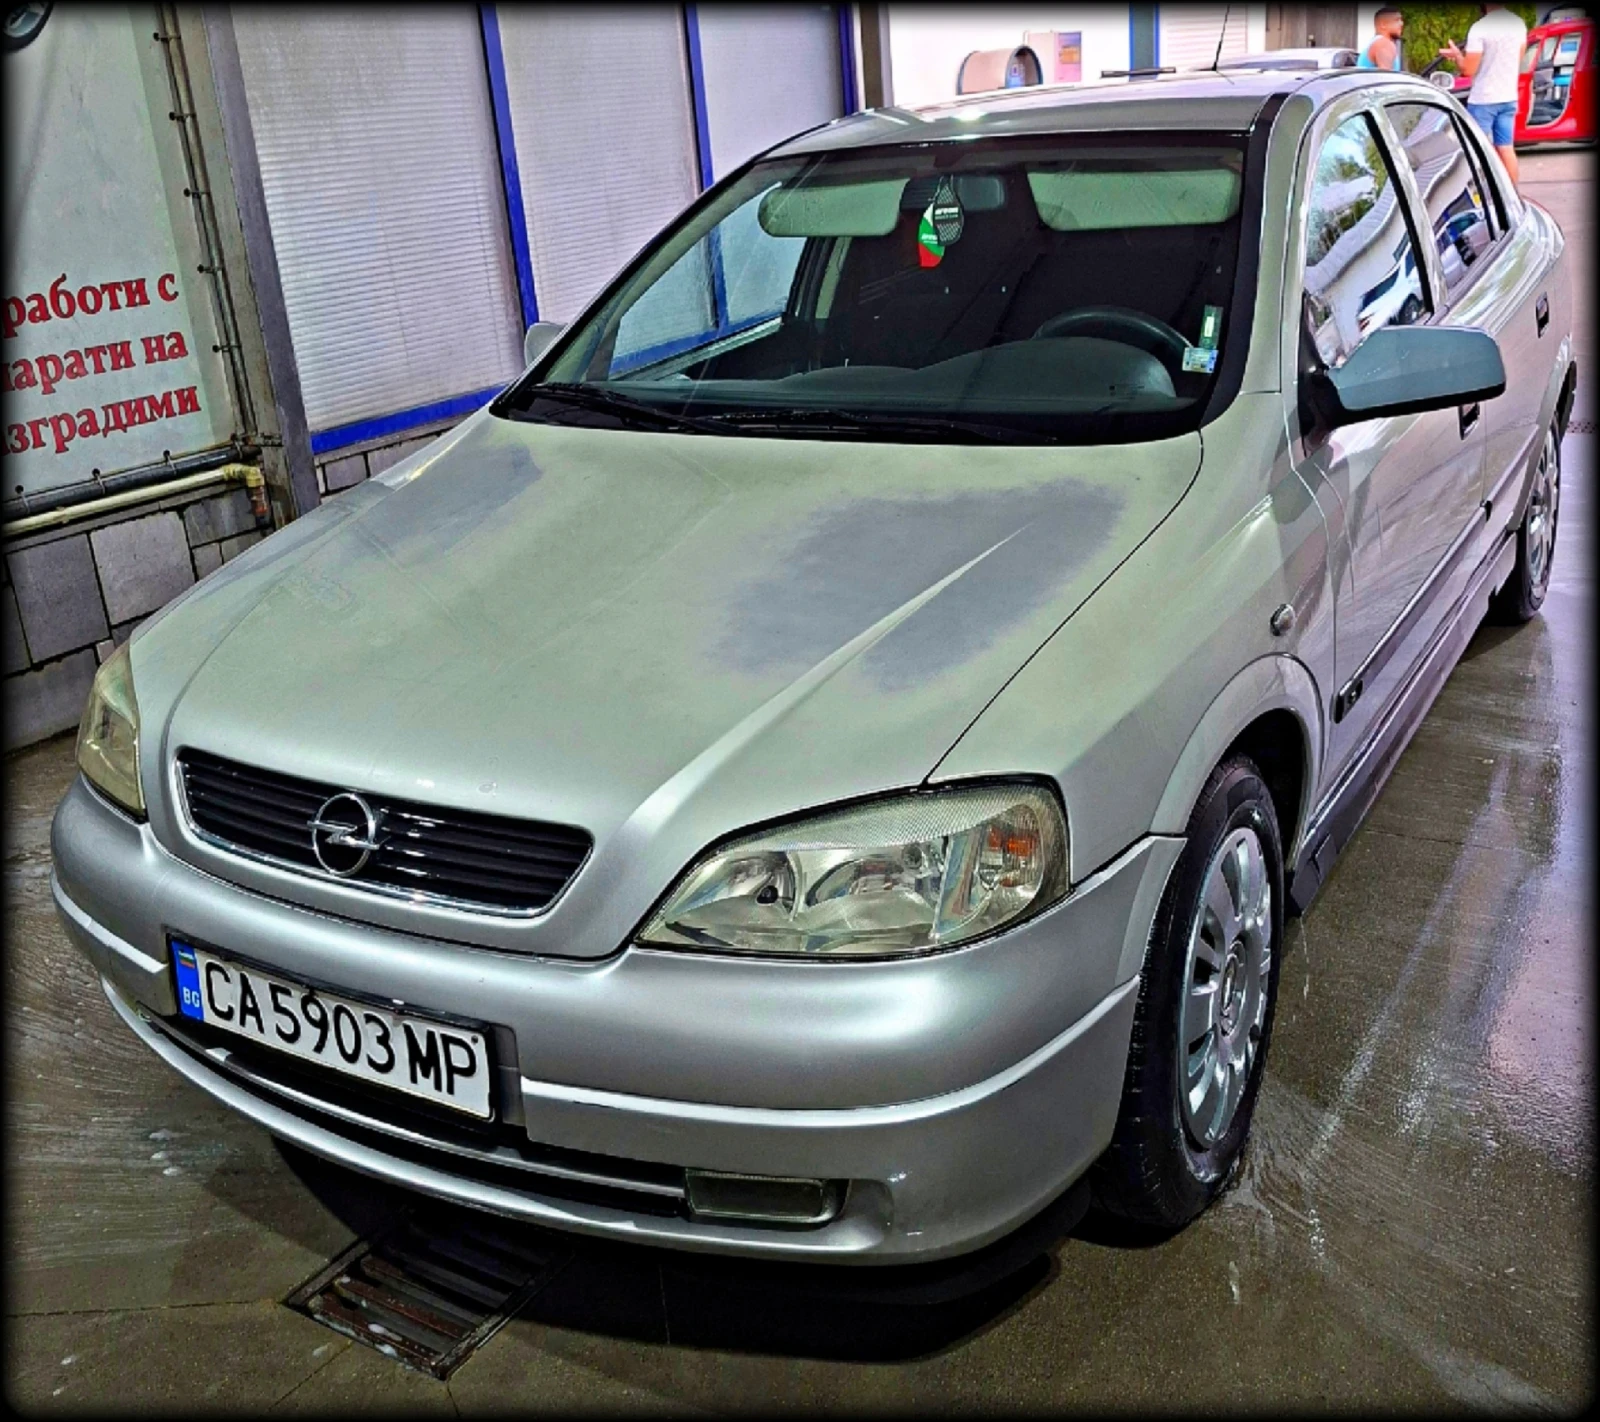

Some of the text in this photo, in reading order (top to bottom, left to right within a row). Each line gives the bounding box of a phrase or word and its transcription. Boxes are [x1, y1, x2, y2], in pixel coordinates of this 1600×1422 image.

[2, 273, 179, 339] работи с
[140, 331, 189, 365] на
[1, 385, 201, 455] зградими
[183, 986, 200, 1008] BG
